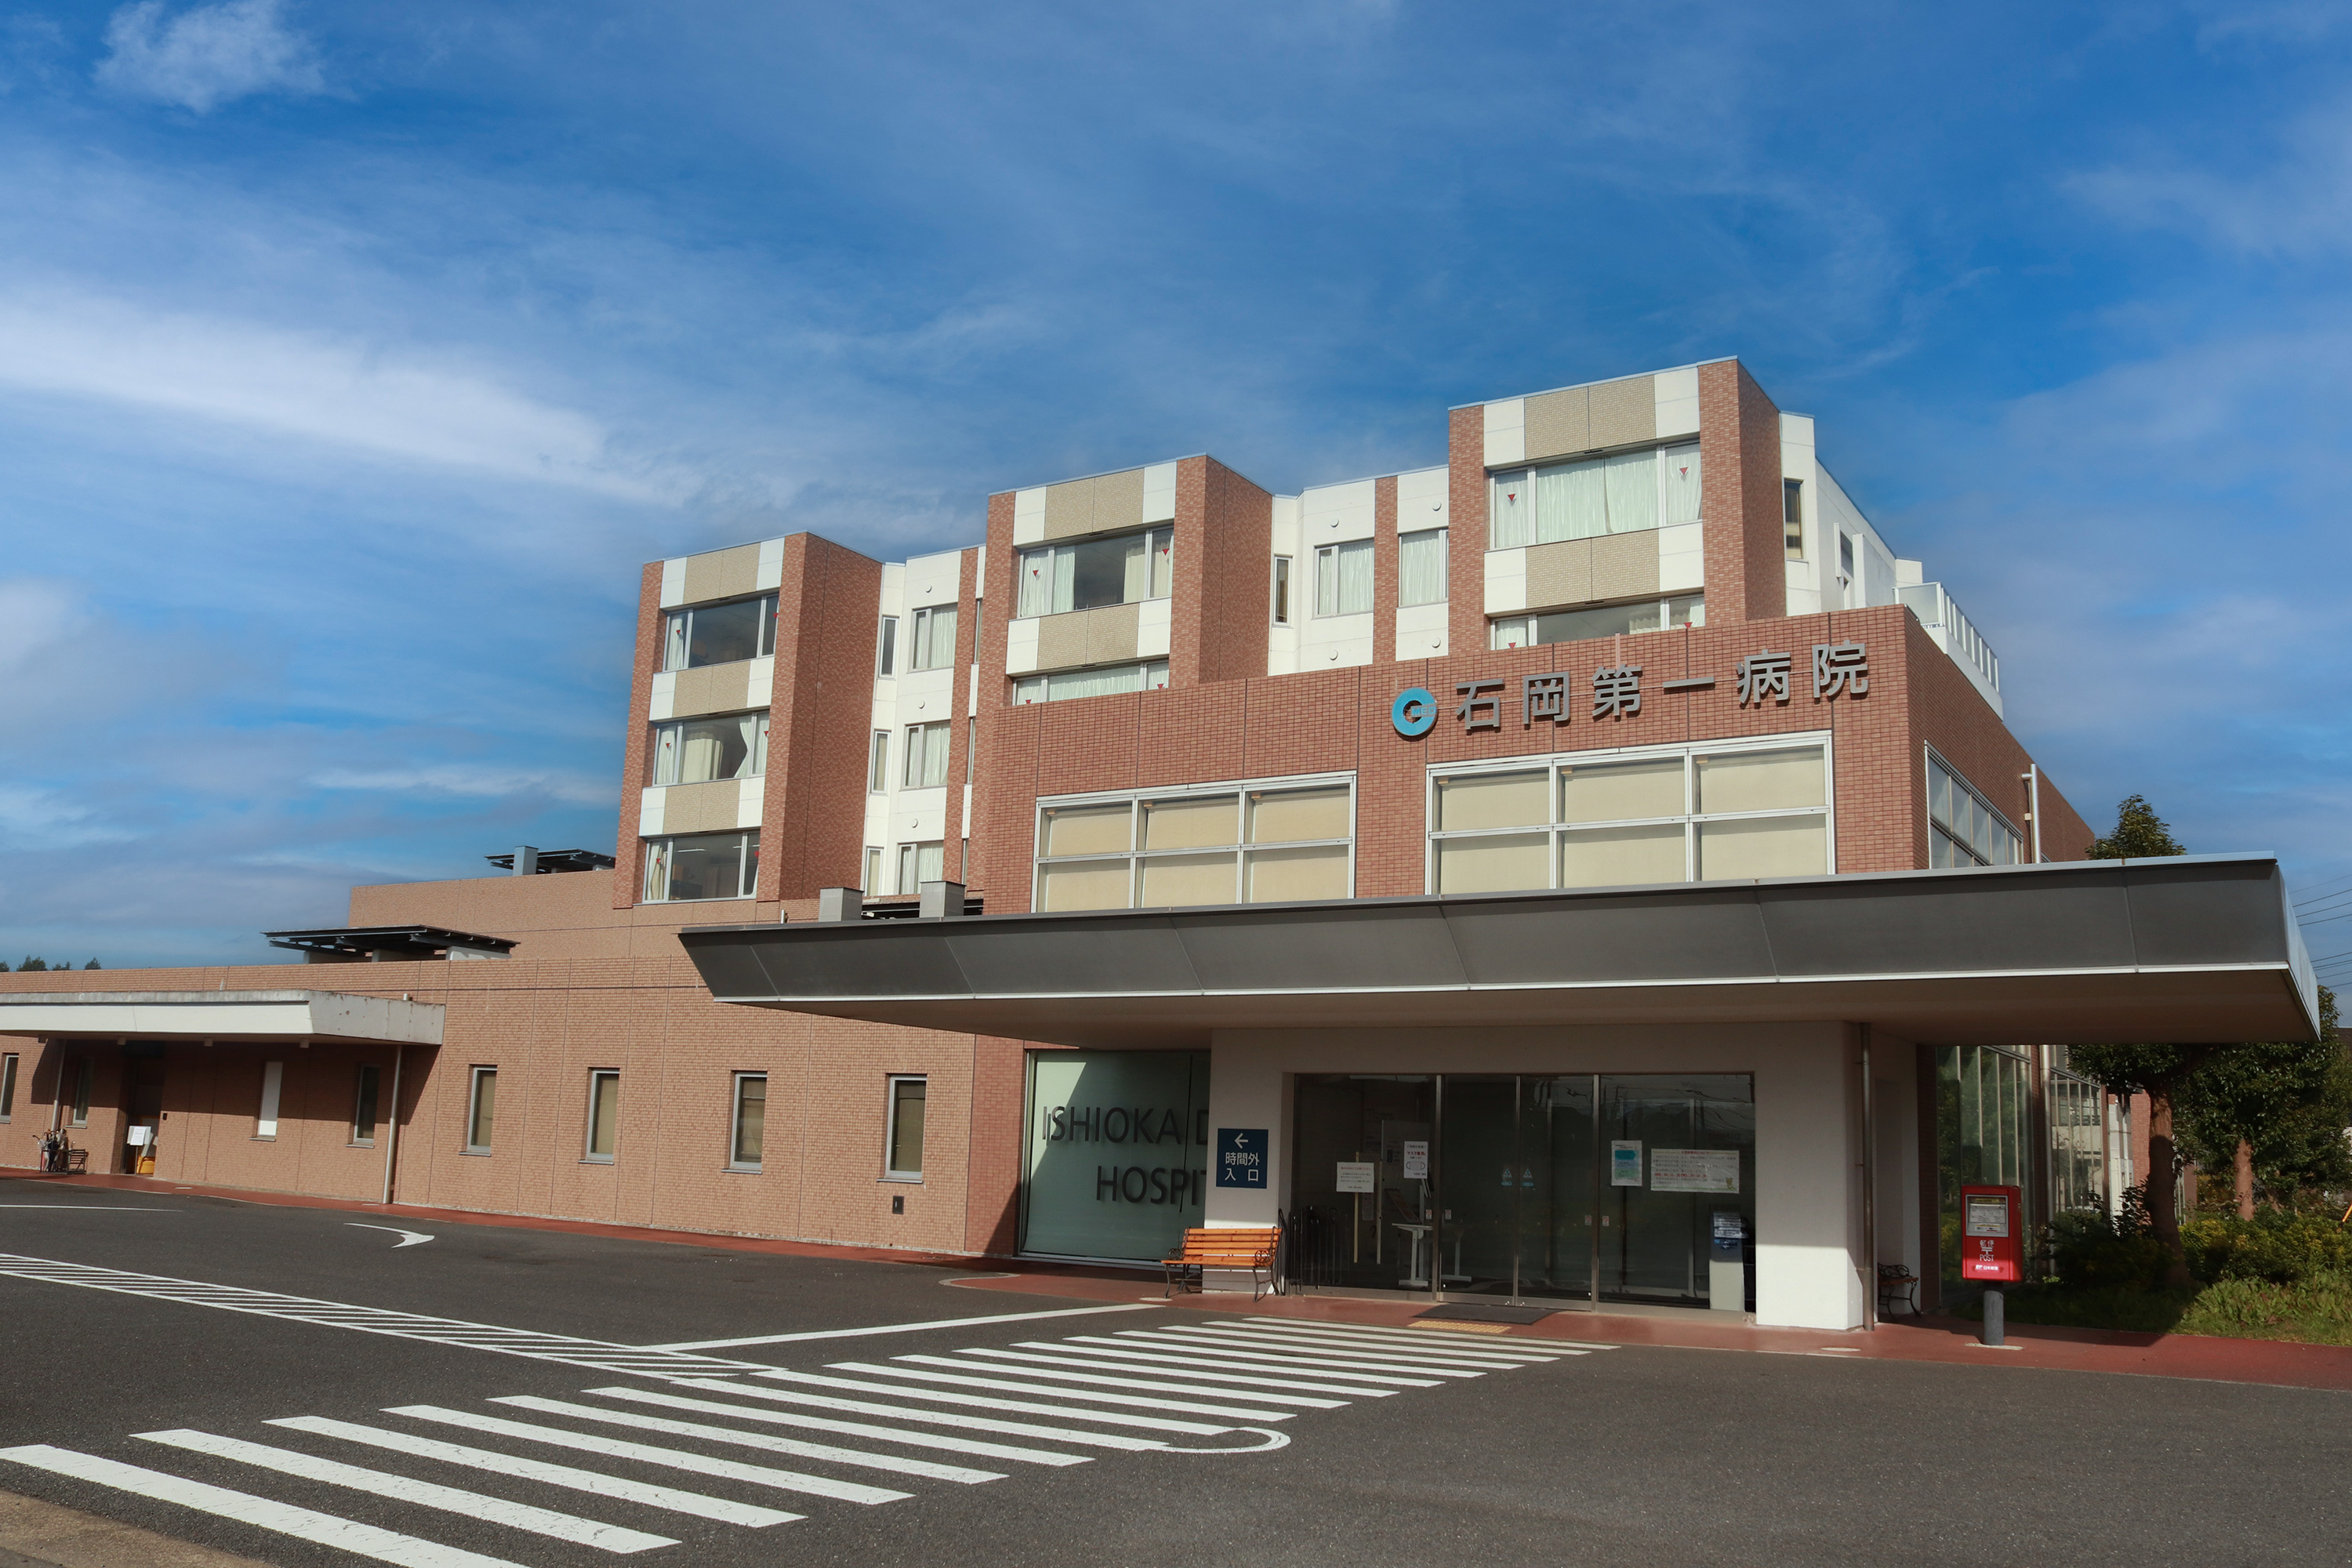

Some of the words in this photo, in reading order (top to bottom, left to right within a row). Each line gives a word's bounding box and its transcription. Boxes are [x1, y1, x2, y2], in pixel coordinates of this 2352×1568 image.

[1455, 639, 1870, 733] 石岡第一病院
[1042, 1106, 1182, 1145] ISHIOKA
[1225, 1152, 1260, 1167] 時間外
[1225, 1167, 1259, 1182] 入口
[1096, 1165, 1207, 1206] HOSPI
